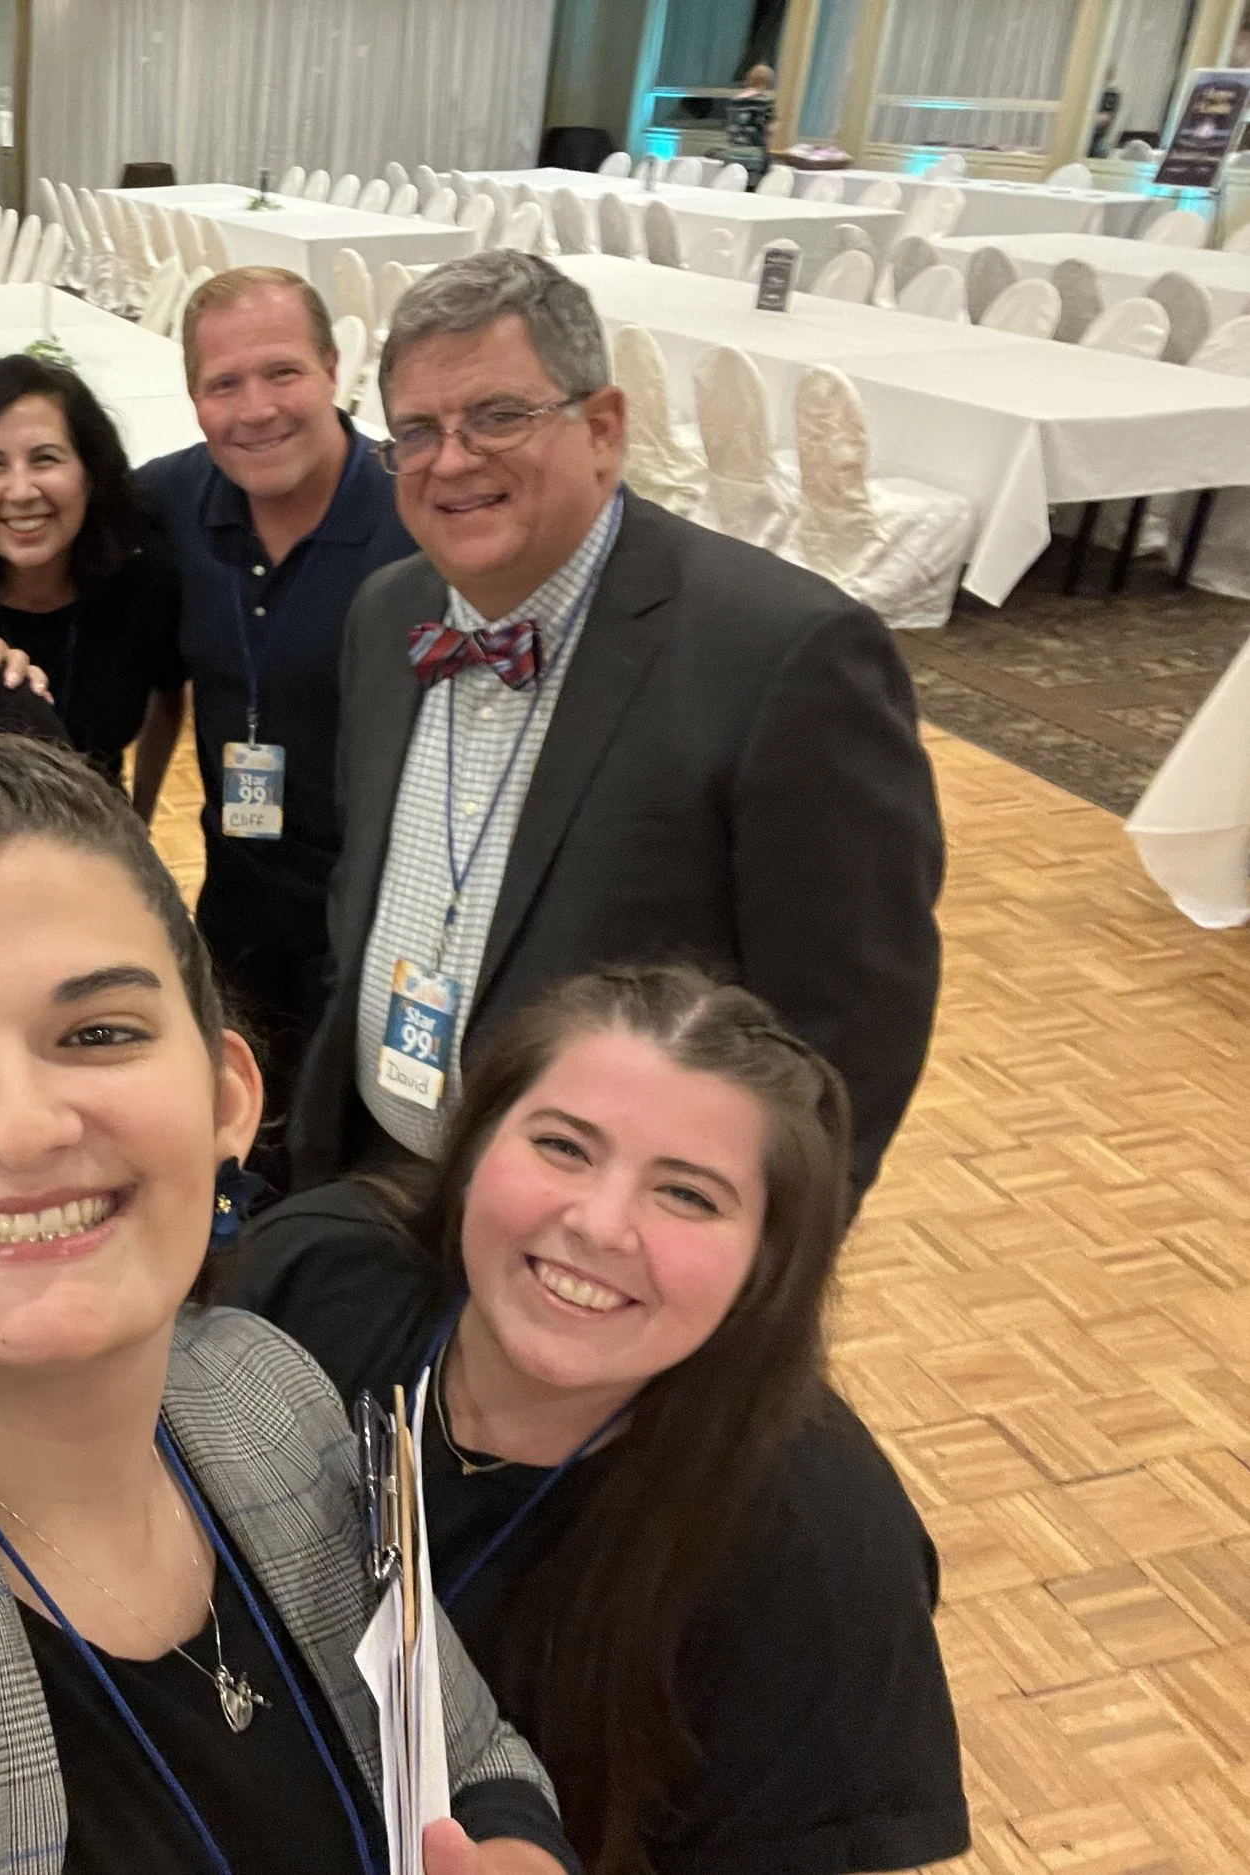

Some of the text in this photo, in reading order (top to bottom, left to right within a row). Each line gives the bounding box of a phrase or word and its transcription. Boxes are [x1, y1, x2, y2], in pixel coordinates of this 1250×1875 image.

[238, 785, 267, 805] 99
[401, 1024, 434, 1059] 99
[386, 1060, 430, 1095] David
